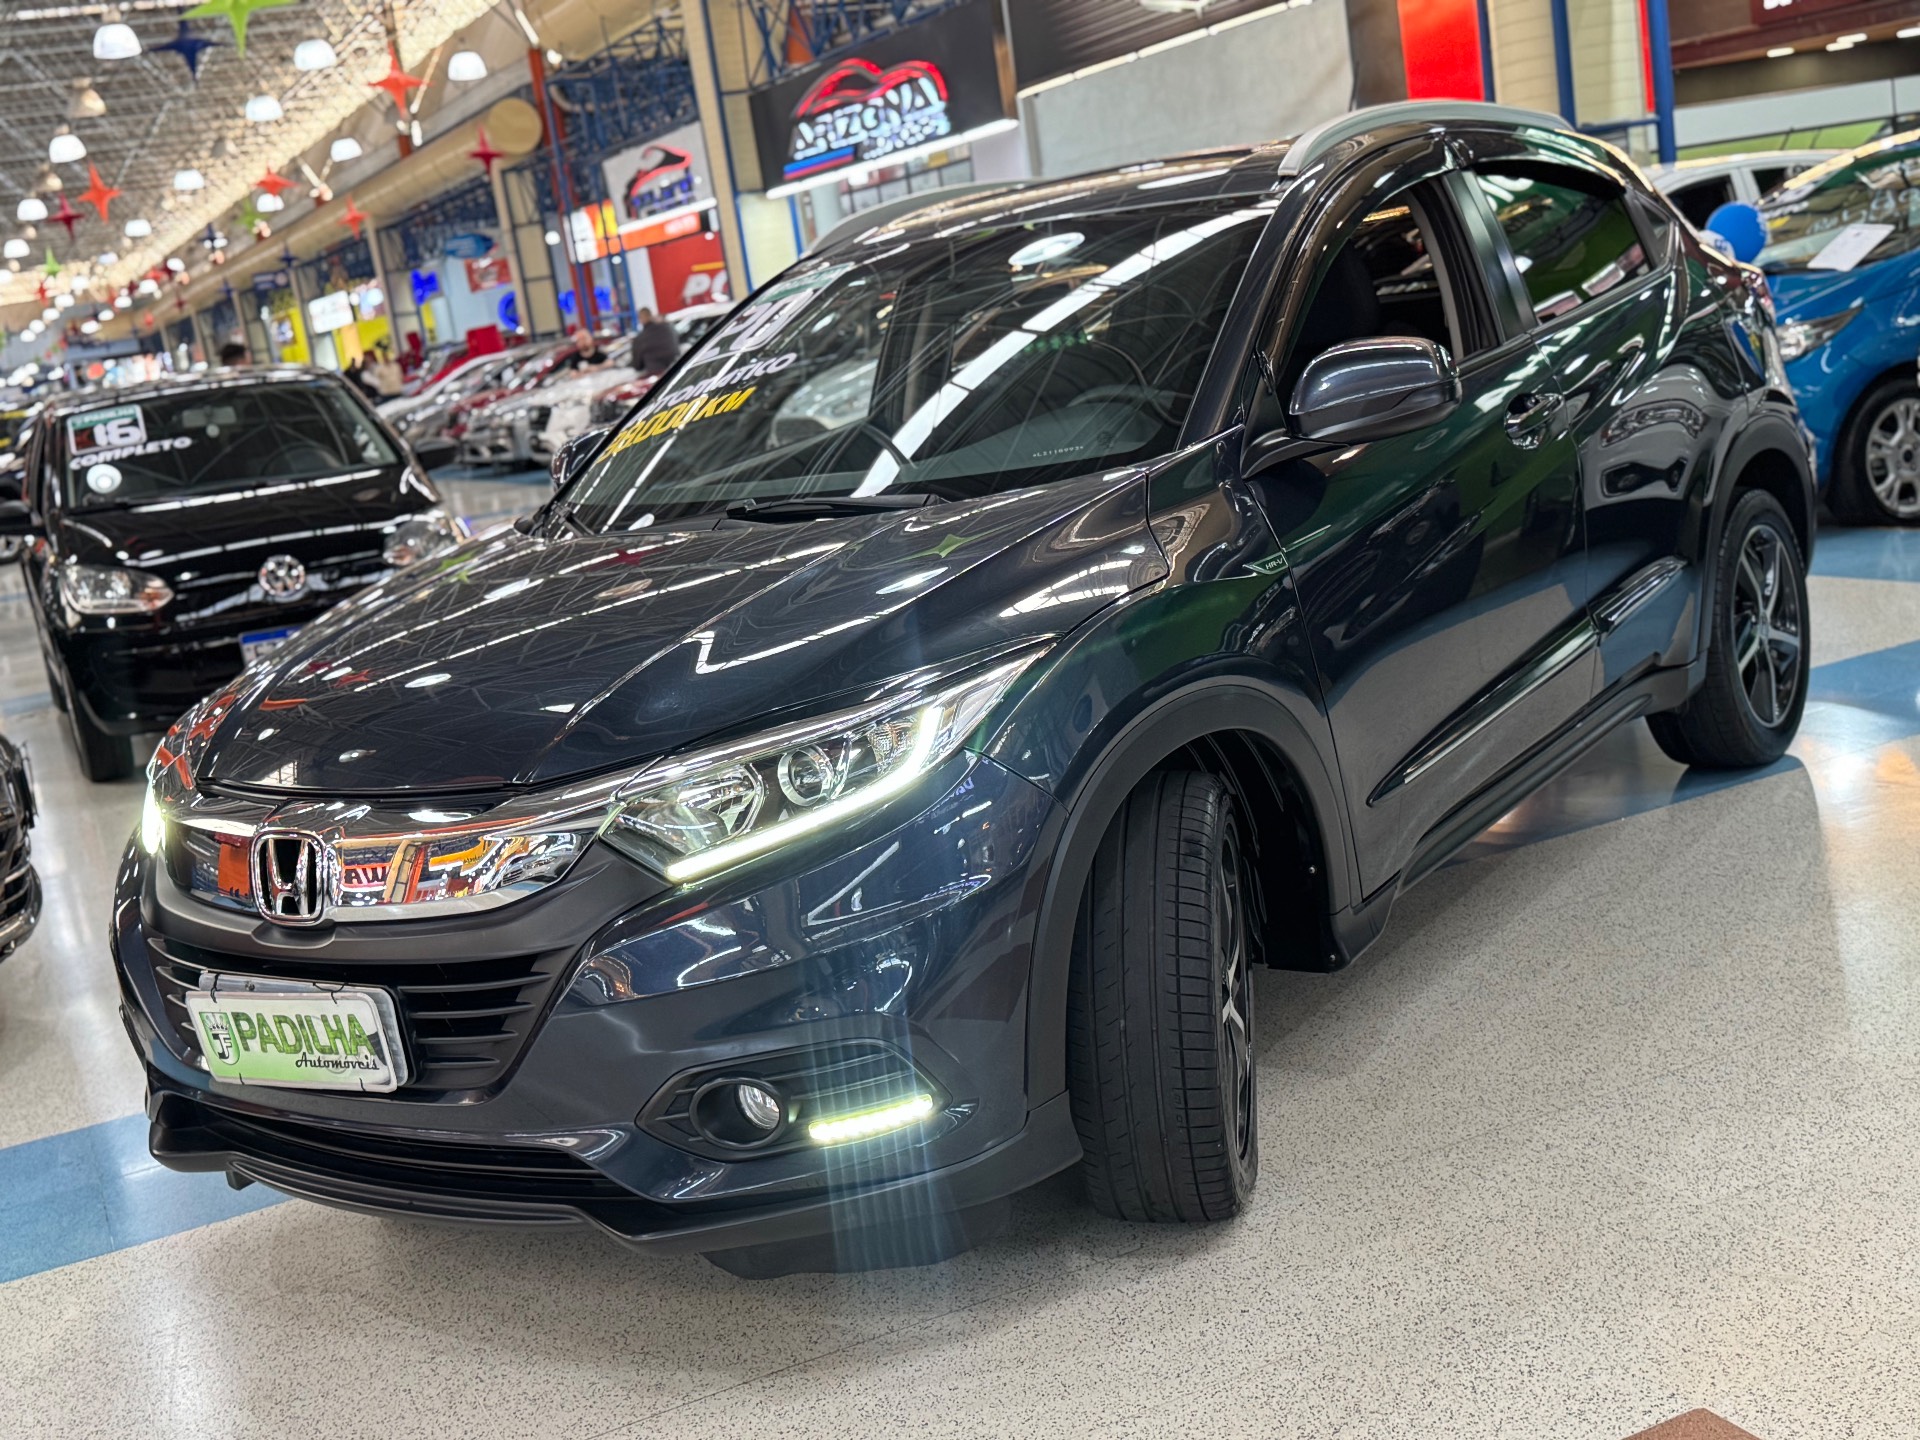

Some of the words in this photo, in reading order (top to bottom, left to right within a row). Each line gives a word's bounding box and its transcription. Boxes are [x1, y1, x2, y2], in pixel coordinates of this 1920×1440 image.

[93, 418, 142, 448] 16
[1265, 557, 1284, 570] HR-V
[231, 1011, 376, 1056] PADILHA
